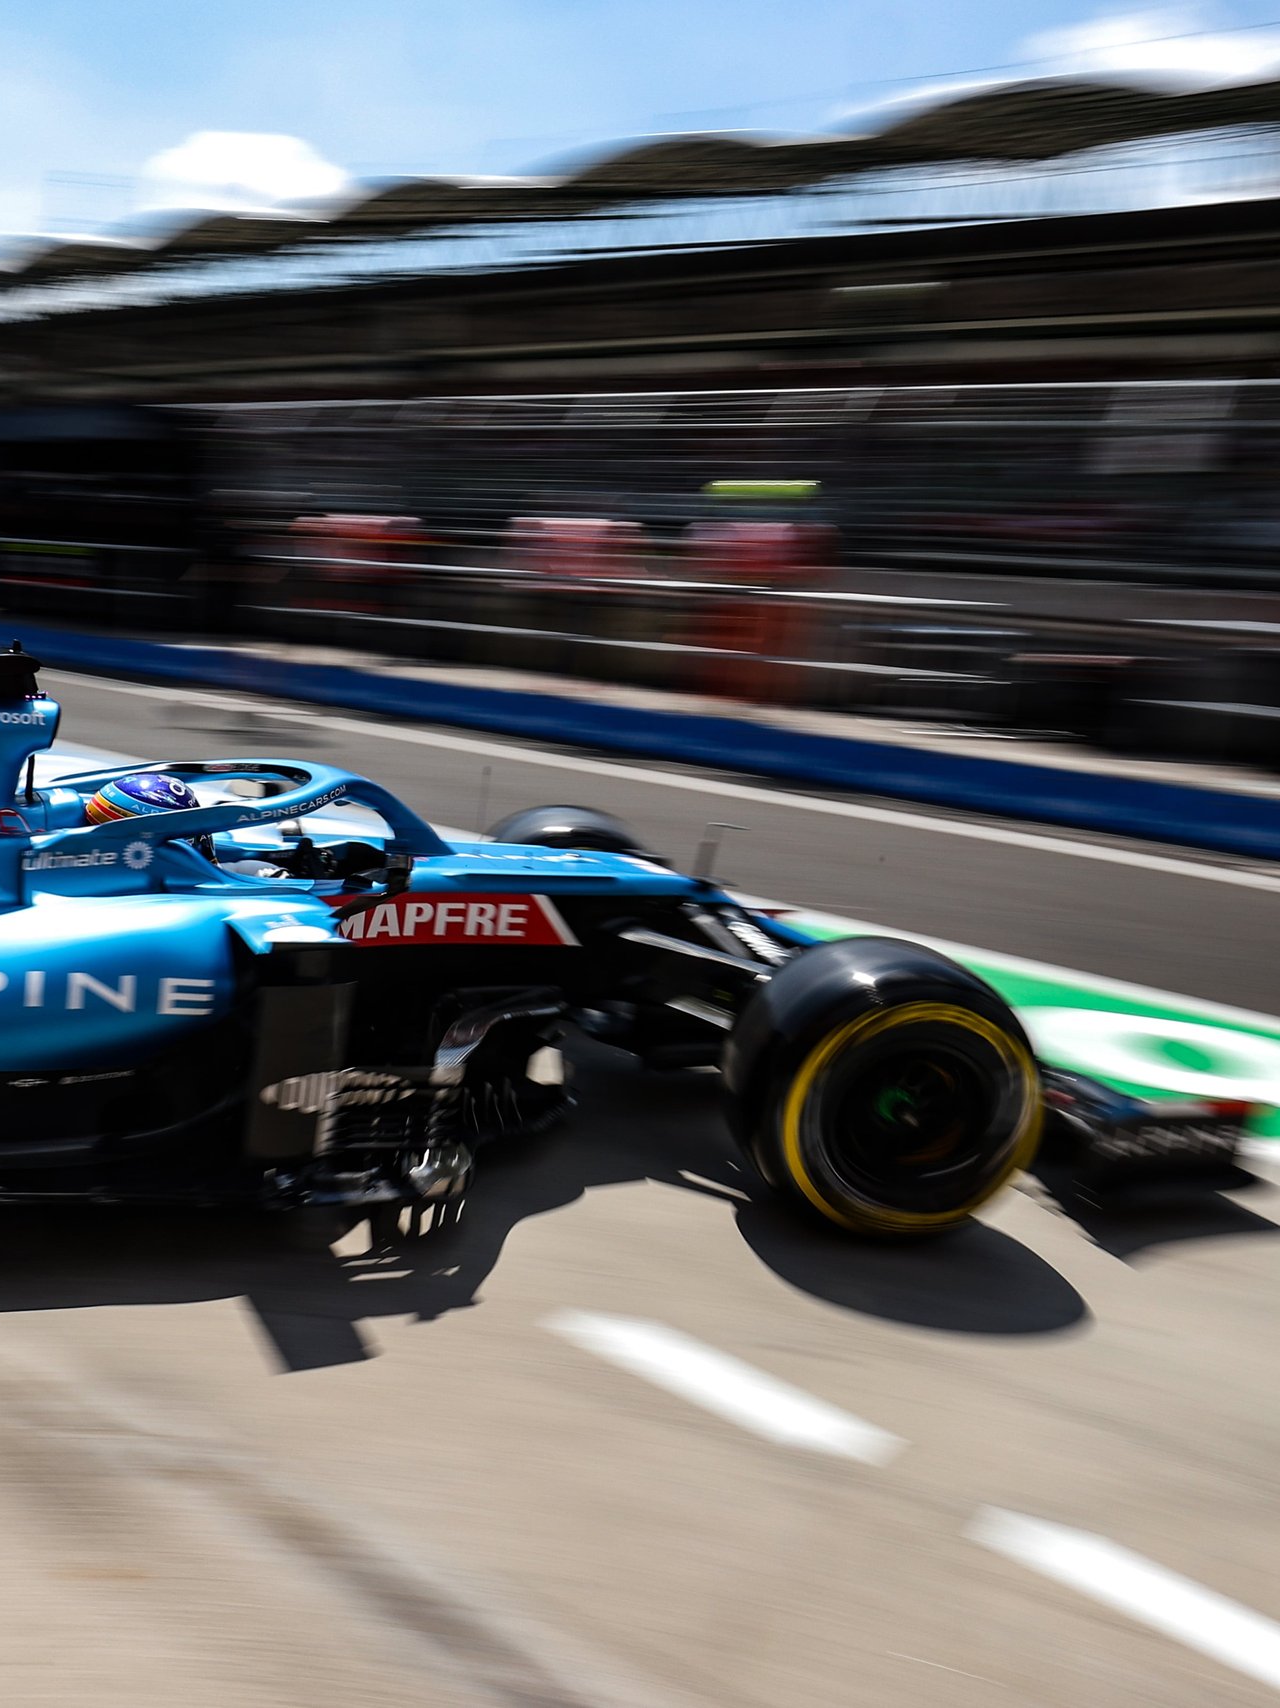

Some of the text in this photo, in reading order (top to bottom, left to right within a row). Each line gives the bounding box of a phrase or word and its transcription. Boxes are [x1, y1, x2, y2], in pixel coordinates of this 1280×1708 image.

[237, 785, 346, 823] ALPINECARS.COM
[22, 849, 118, 871] ultimate
[332, 902, 531, 940] MAPFRE
